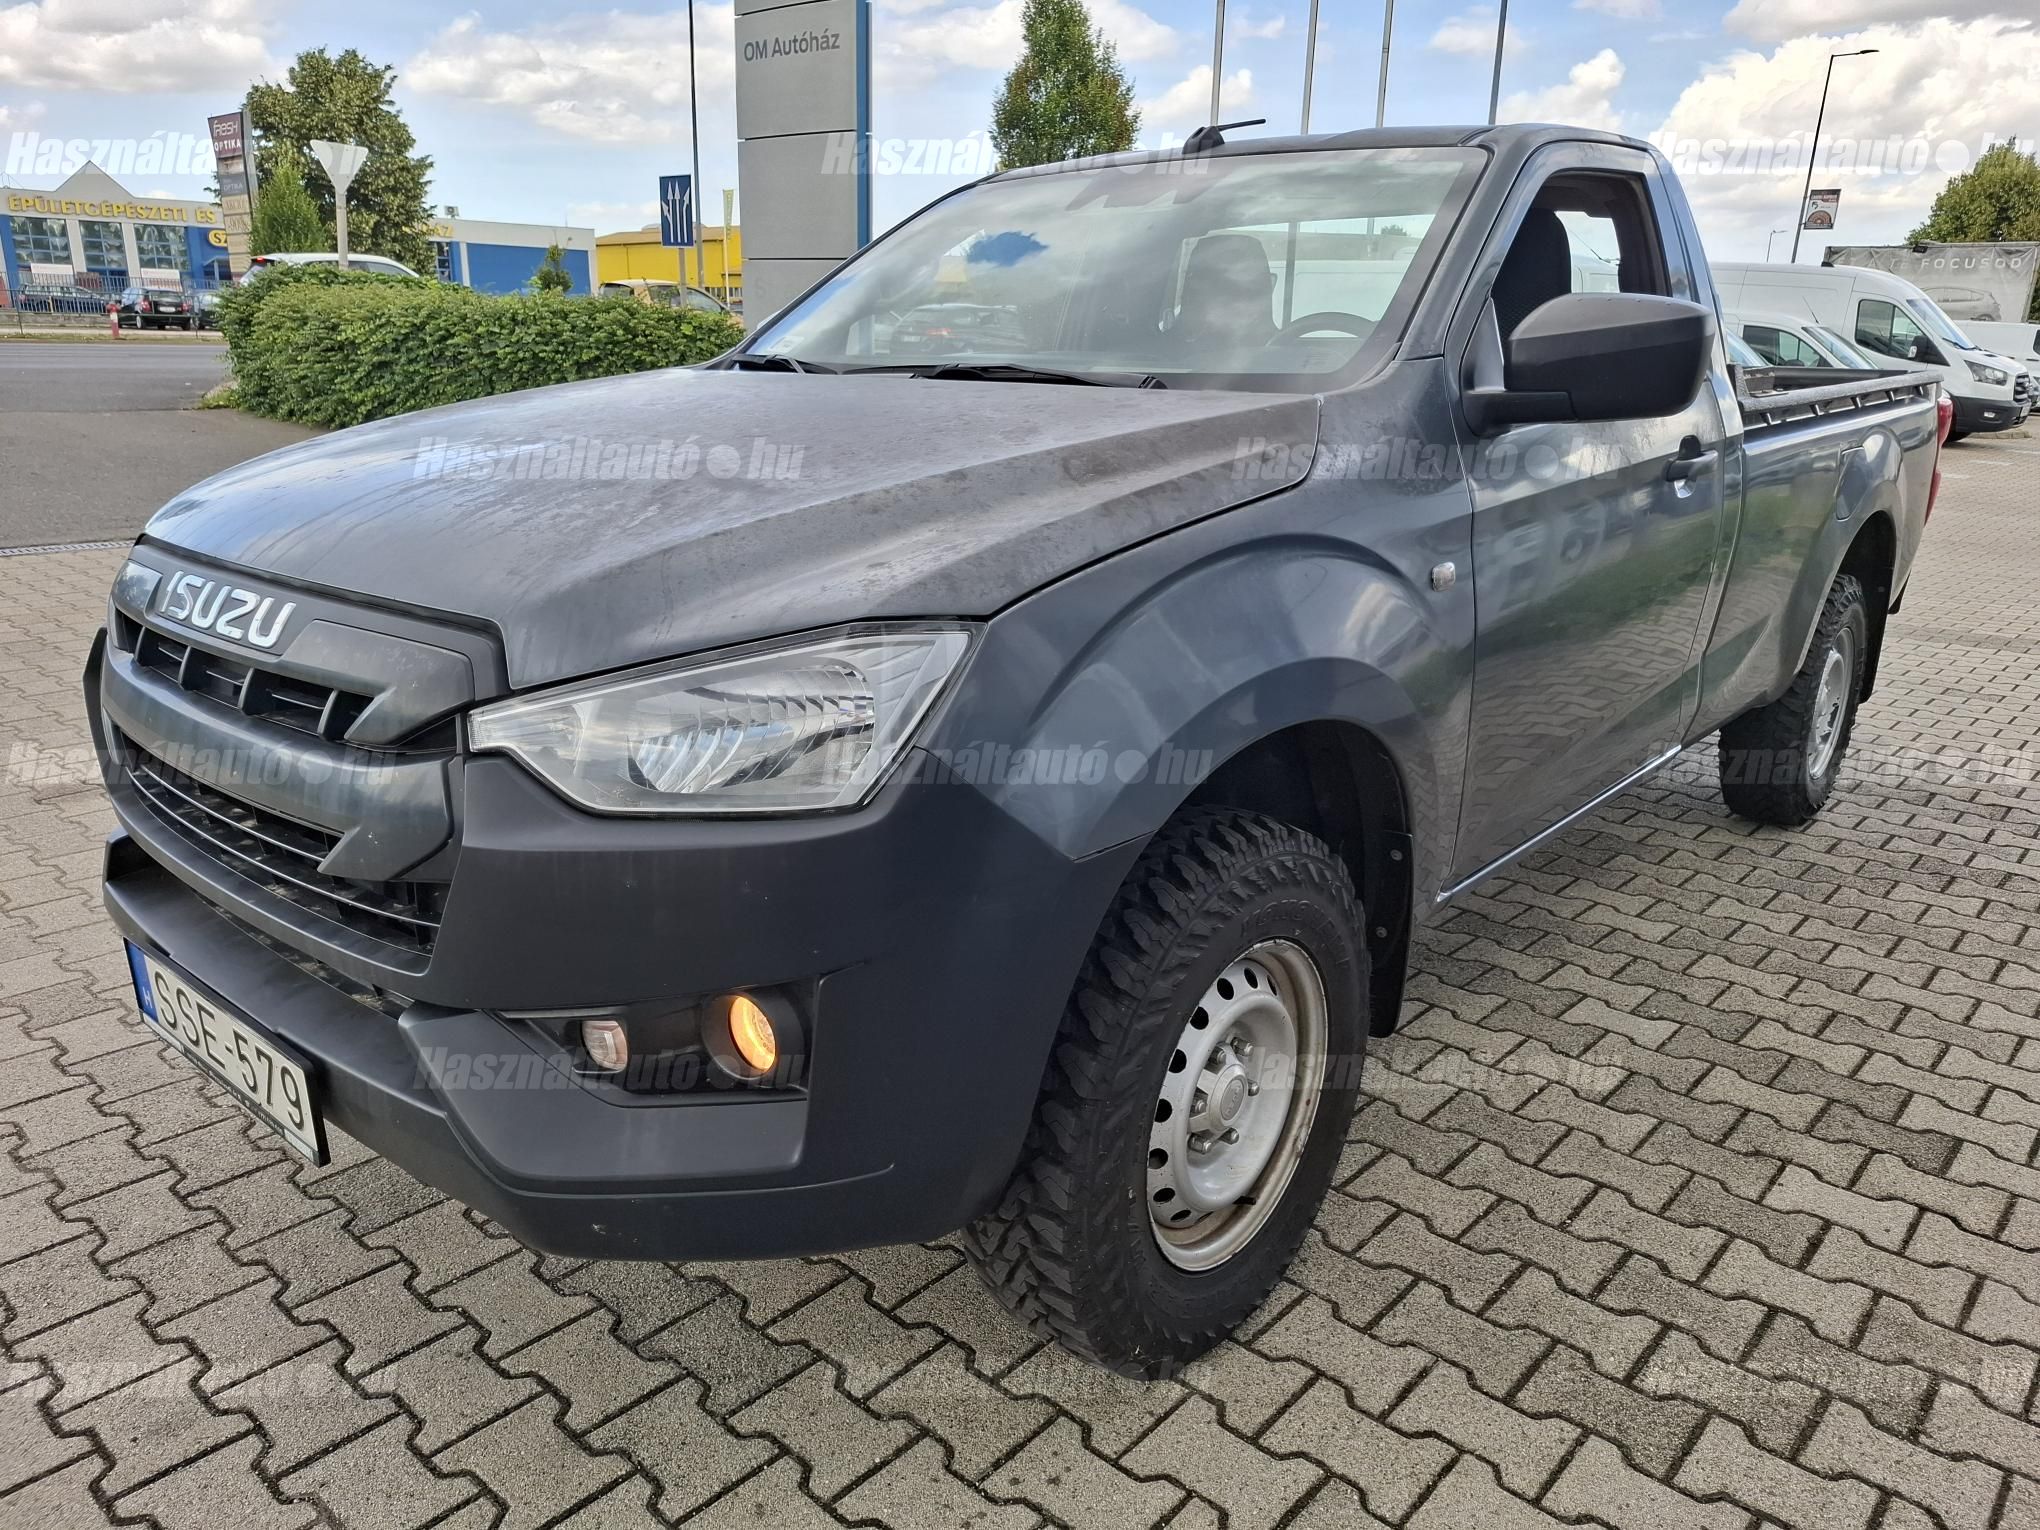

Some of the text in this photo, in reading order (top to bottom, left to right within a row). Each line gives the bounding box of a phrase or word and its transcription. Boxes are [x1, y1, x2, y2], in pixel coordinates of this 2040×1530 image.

[744, 28, 841, 62] OM Autóház
[214, 139, 241, 152] OPTIKA
[1920, 257, 2022, 270] FOCUSOD
[158, 570, 297, 649] ISUZU
[154, 970, 305, 1132] SSE-579
